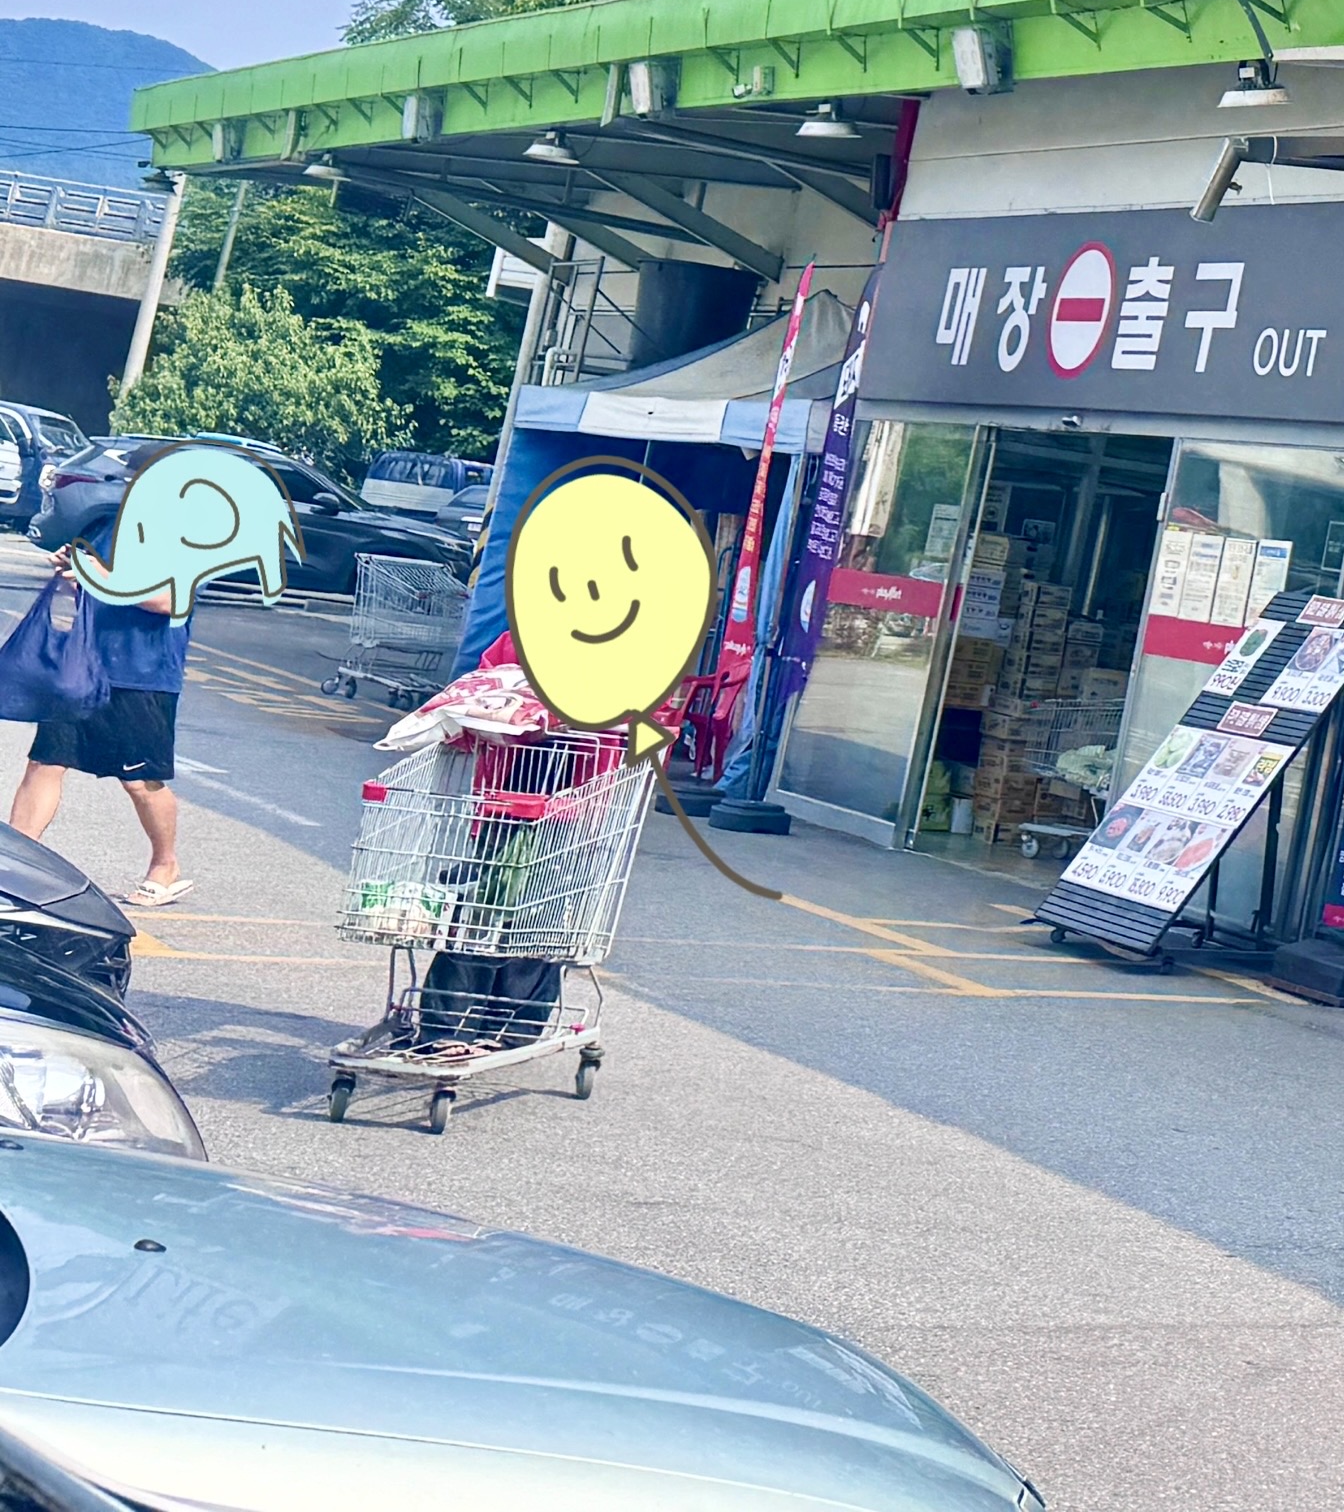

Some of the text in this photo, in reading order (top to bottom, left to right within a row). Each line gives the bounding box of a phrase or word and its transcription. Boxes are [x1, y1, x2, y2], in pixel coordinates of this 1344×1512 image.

[934, 264, 1046, 373] 매장
[1115, 256, 1241, 374] 출구
[1252, 328, 1327, 378] OUT
